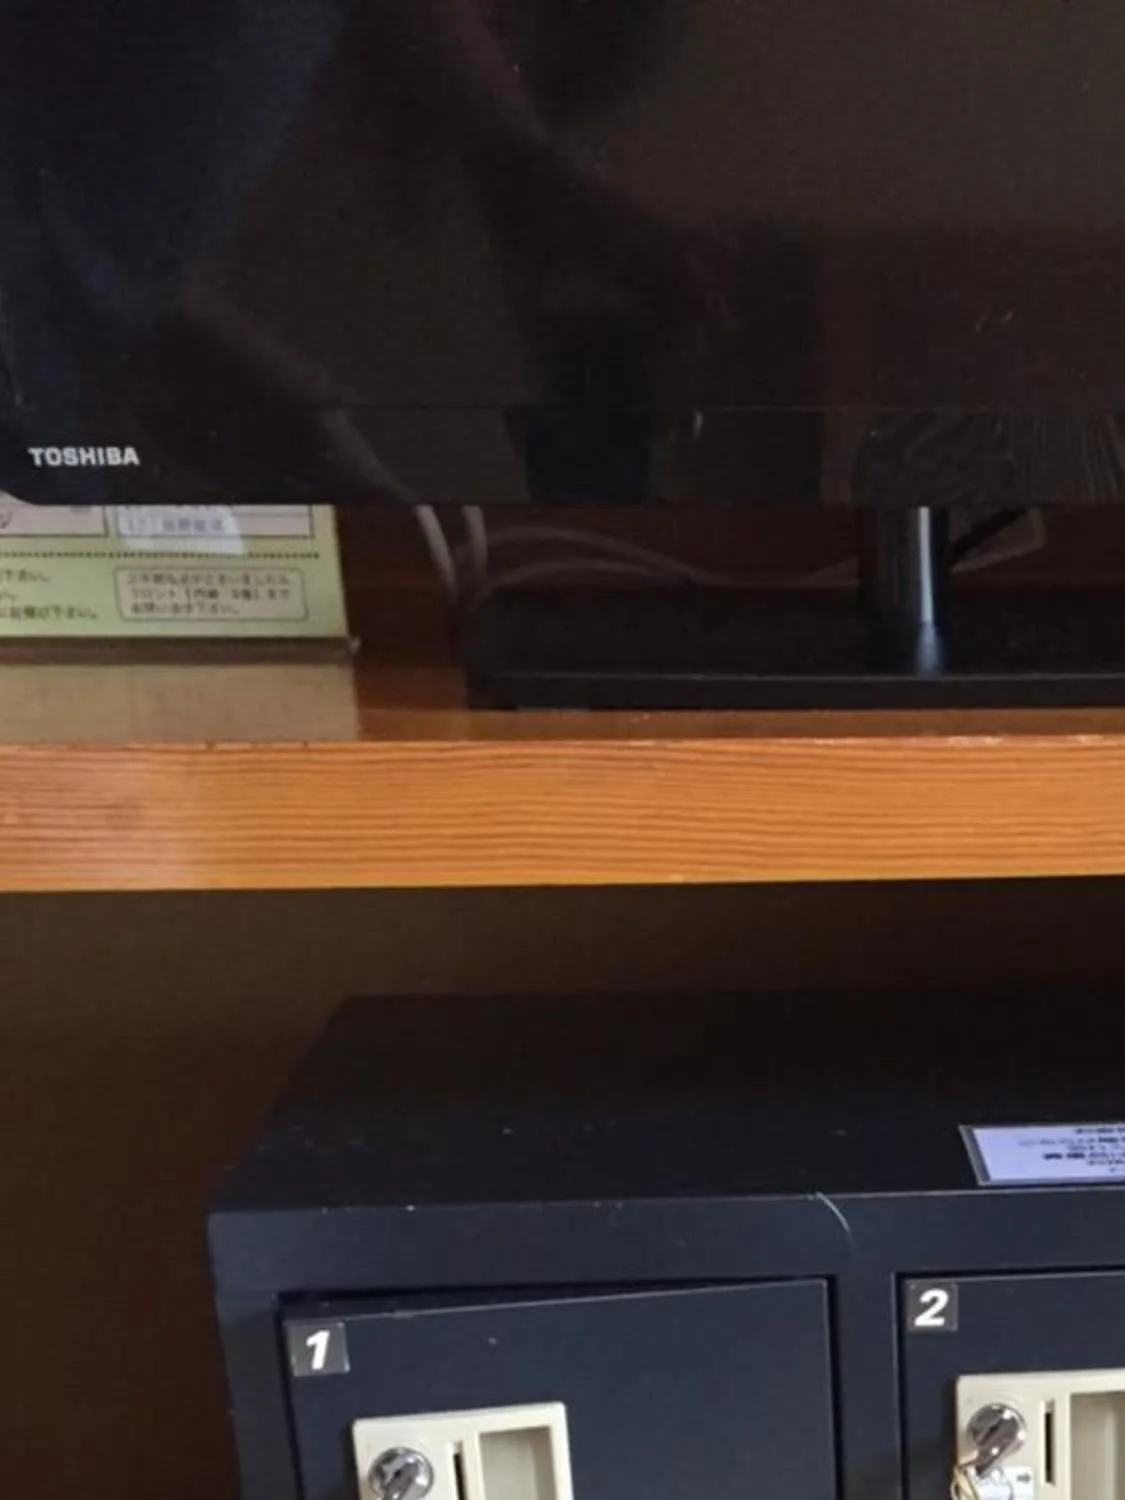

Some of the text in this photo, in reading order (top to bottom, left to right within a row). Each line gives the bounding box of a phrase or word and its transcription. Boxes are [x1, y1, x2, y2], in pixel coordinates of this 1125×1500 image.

[27, 447, 140, 467] TOSHIBA
[914, 1289, 949, 1327] 2
[305, 1330, 330, 1371] 1
